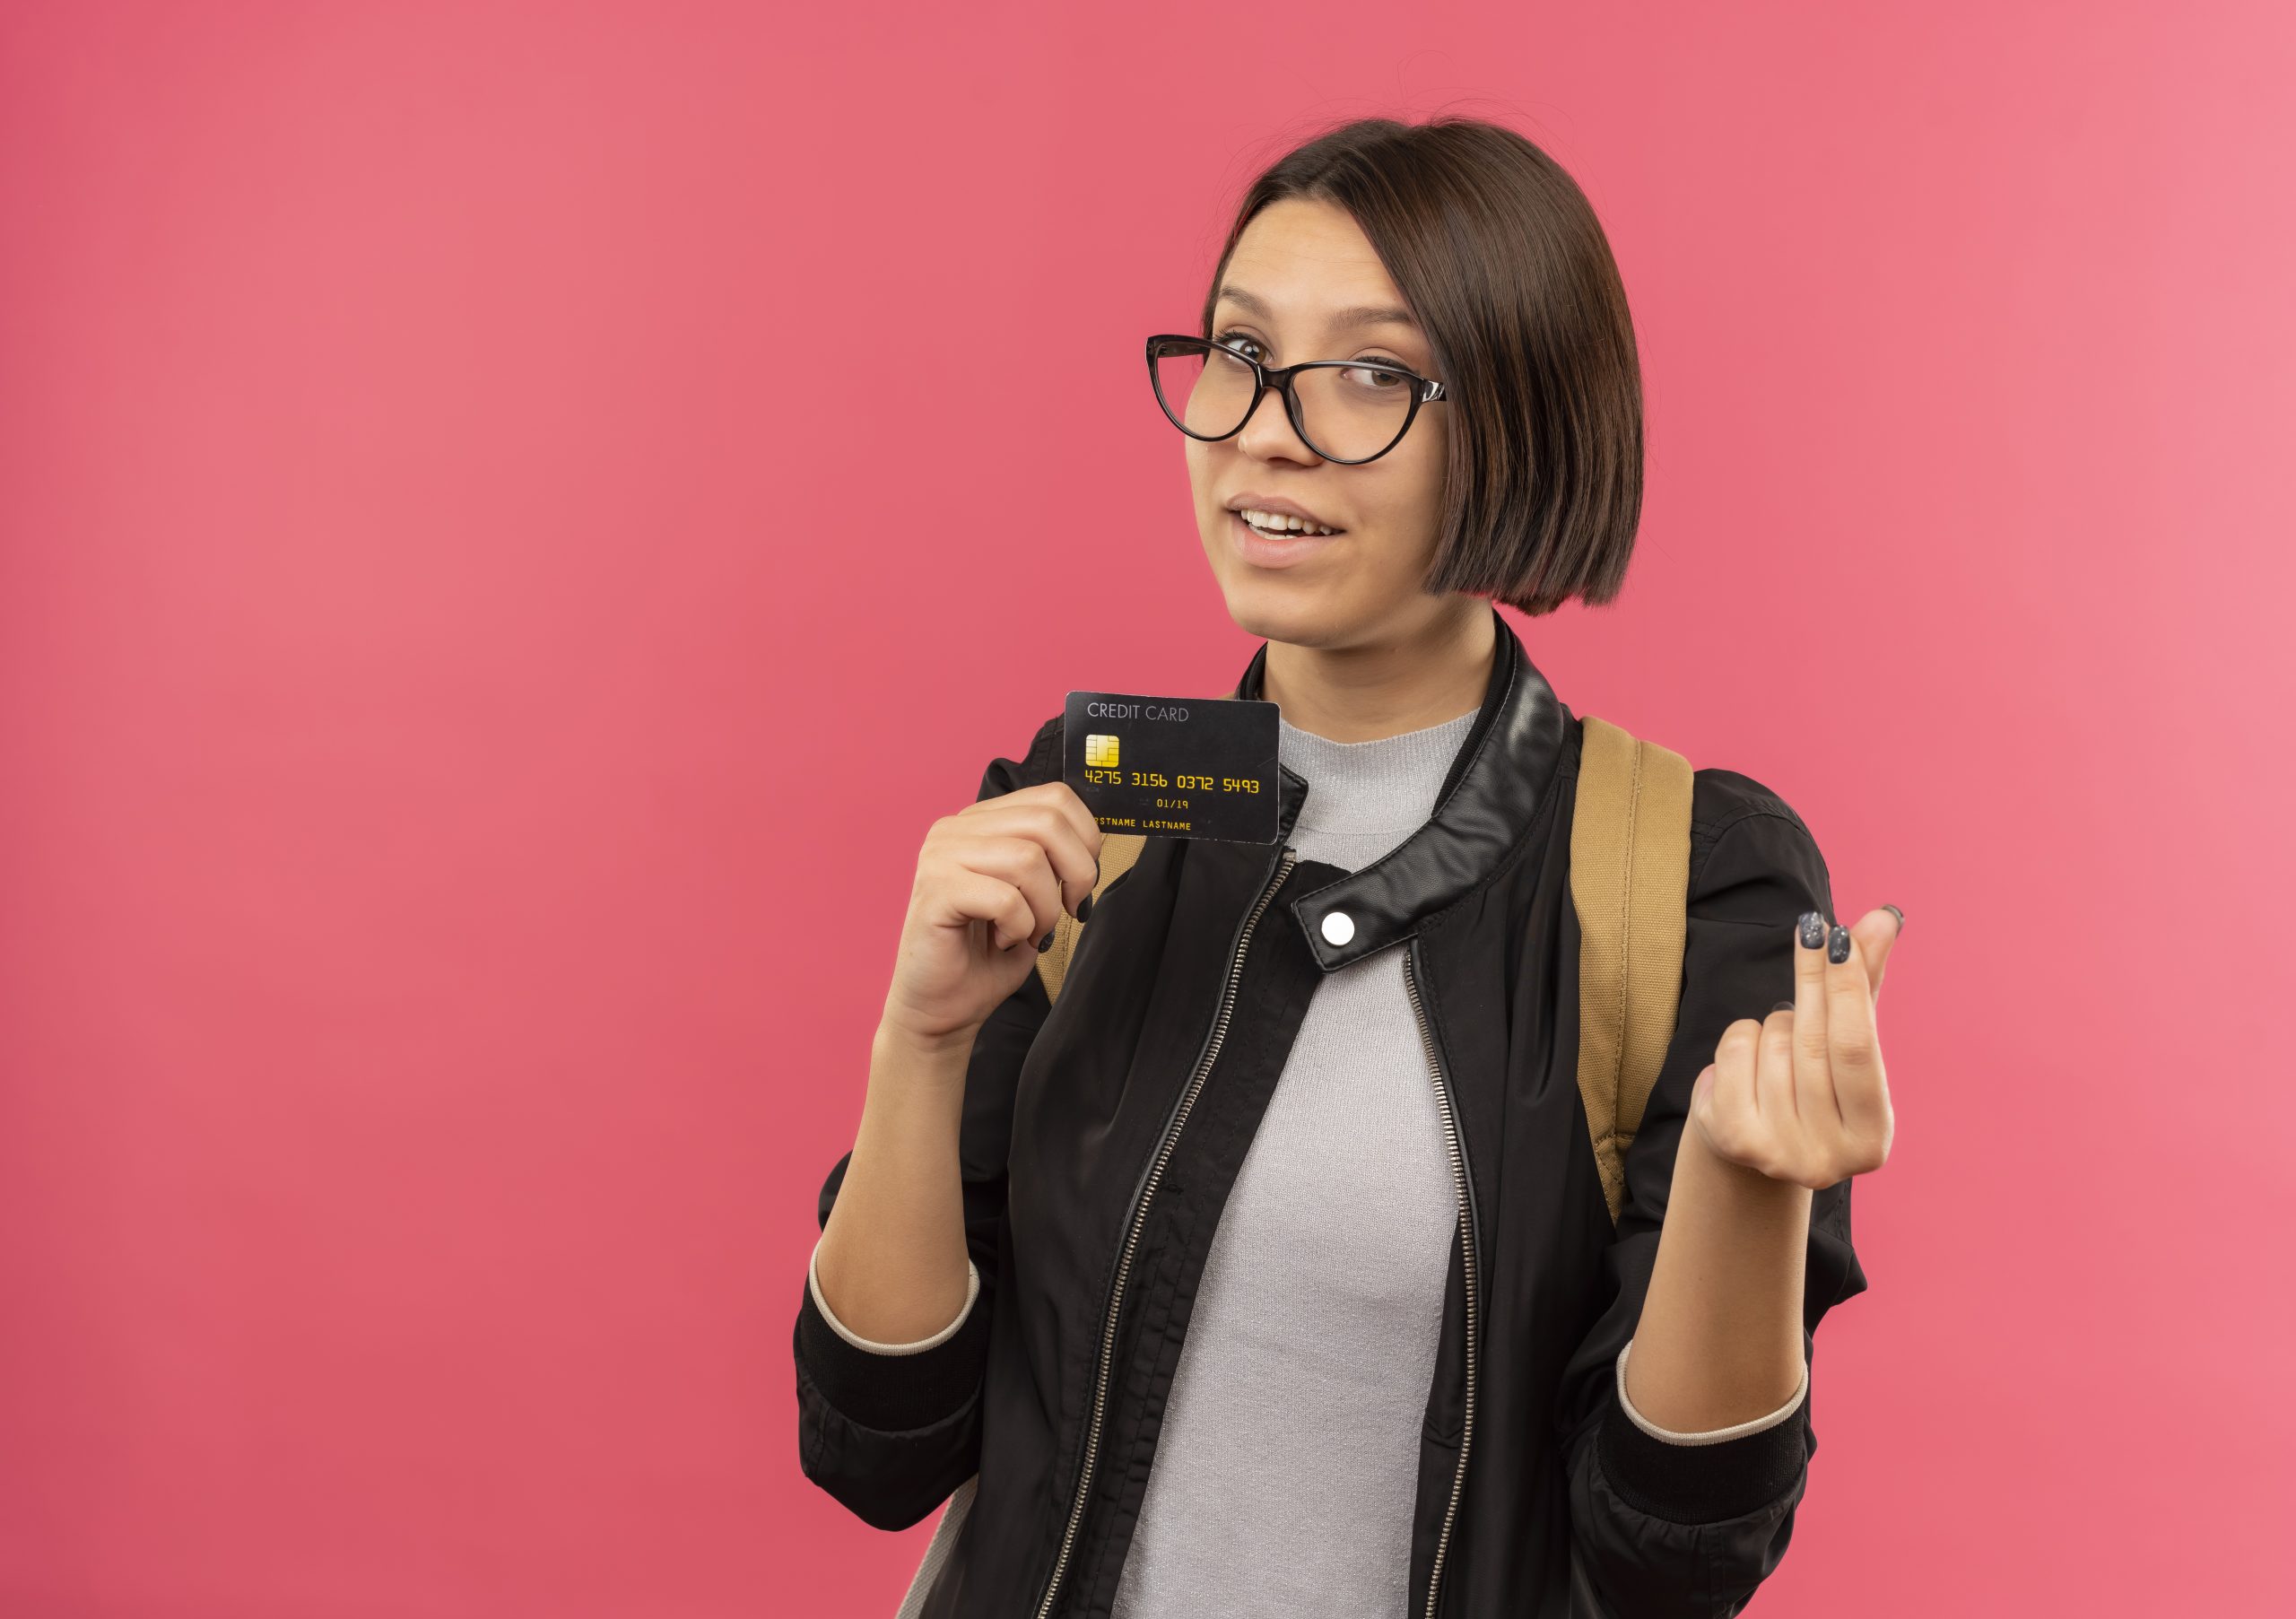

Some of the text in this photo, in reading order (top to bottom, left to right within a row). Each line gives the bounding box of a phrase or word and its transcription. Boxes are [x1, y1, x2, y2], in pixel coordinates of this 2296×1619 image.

[1087, 702, 1189, 722] CREDIT CARD
[1084, 770, 1260, 794] 4275 3156 0372 5493
[1156, 798, 1189, 809] 01/19
[1143, 820, 1192, 831] LASTNAME
